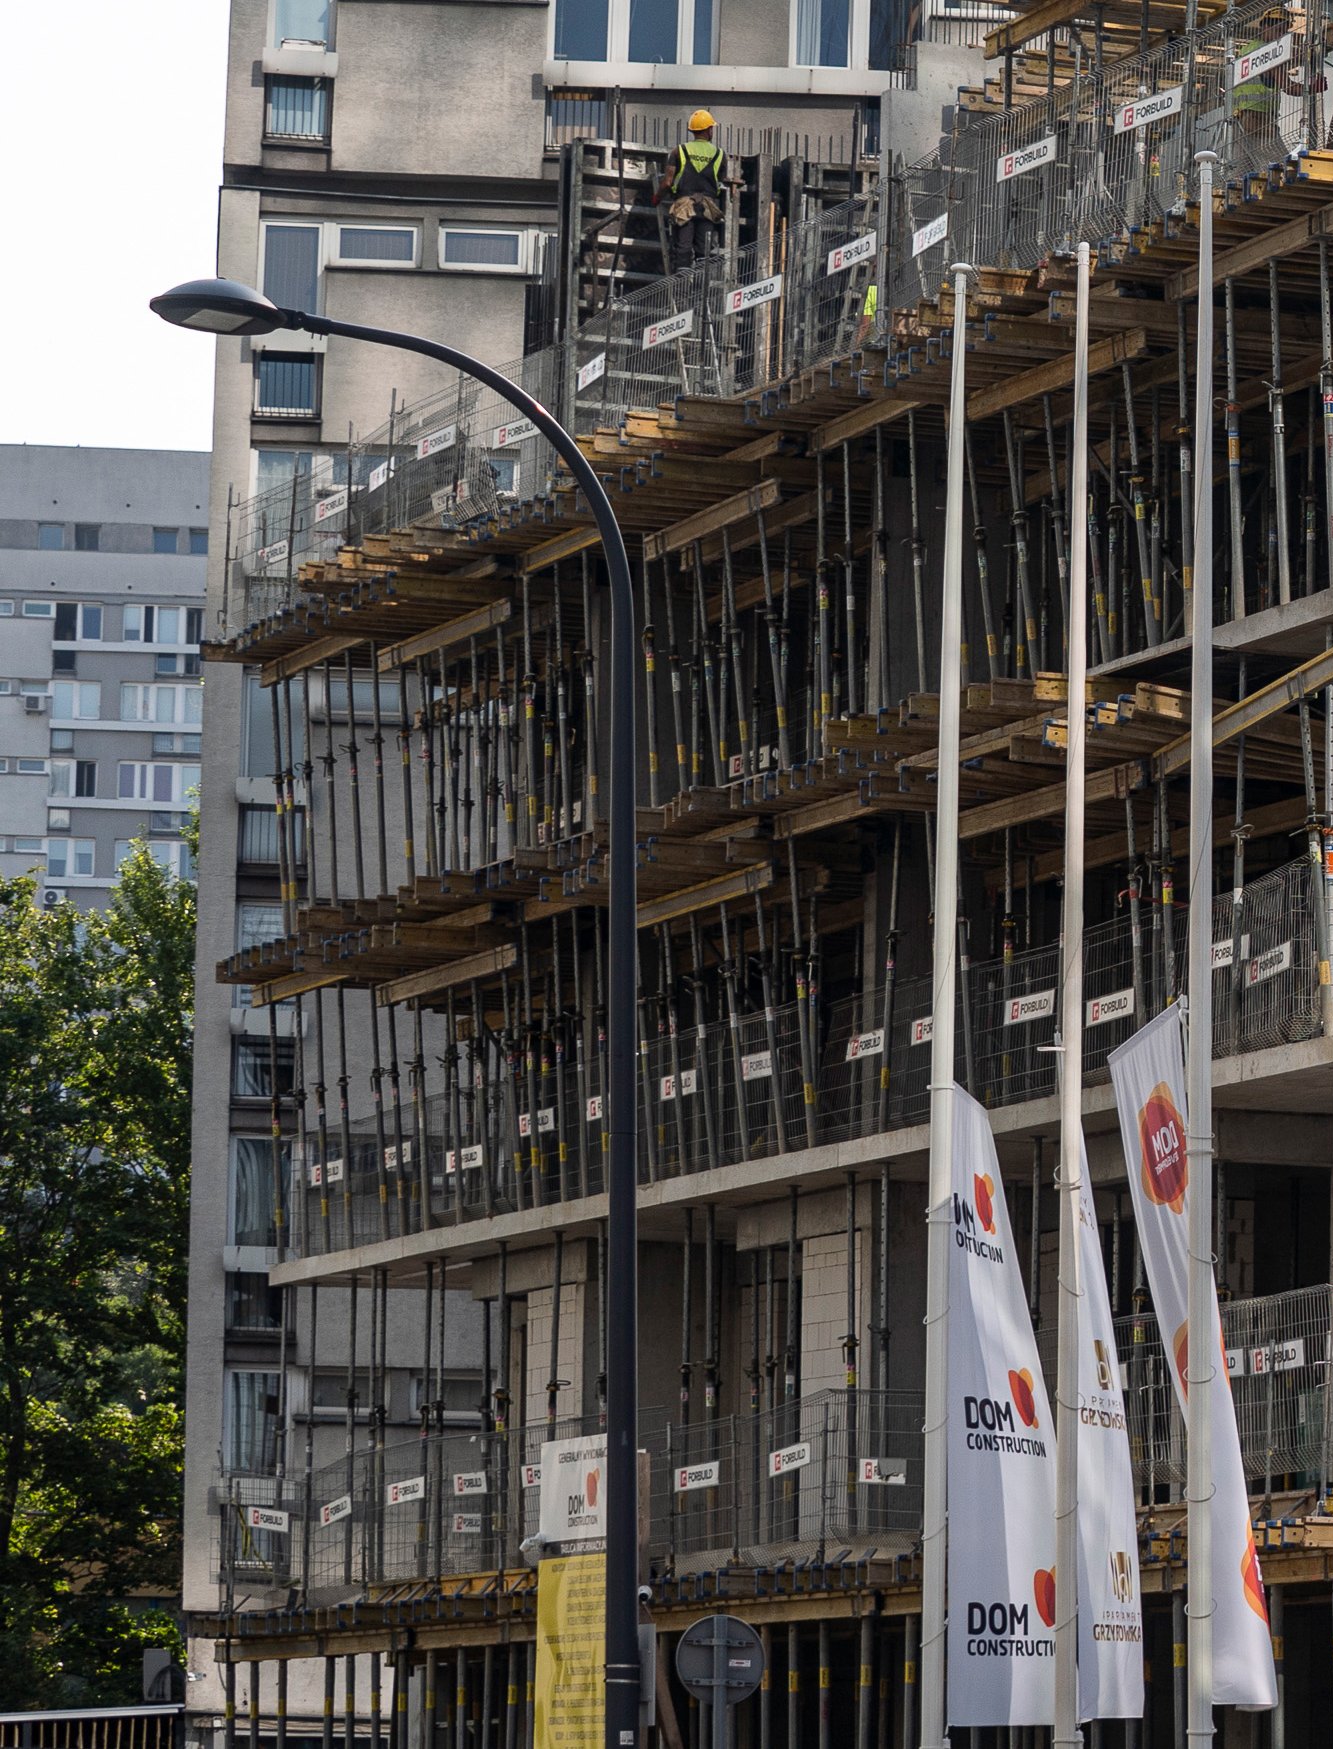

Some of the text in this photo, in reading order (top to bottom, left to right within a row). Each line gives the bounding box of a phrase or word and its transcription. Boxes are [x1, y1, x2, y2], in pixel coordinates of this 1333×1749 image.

[1251, 47, 1284, 71] FORBUILD
[1135, 95, 1173, 120] FORBUILD
[1014, 144, 1048, 168] FORBUILD
[742, 282, 775, 304] FORBUILD
[657, 317, 687, 339] FORBUILD
[428, 430, 452, 450] FORBUILD
[324, 494, 345, 513] FORBUILD
[1020, 997, 1049, 1015] FORBUILD
[1100, 997, 1128, 1018] FORBUILD
[858, 1035, 881, 1051] FORBUILD
[964, 1396, 1015, 1432] DOM
[966, 1432, 1047, 1458] CONSTRUCTION
[568, 1495, 585, 1515] DOM
[967, 1602, 1029, 1635] DOM
[967, 1639, 1056, 1657] CONSTRUCTI
